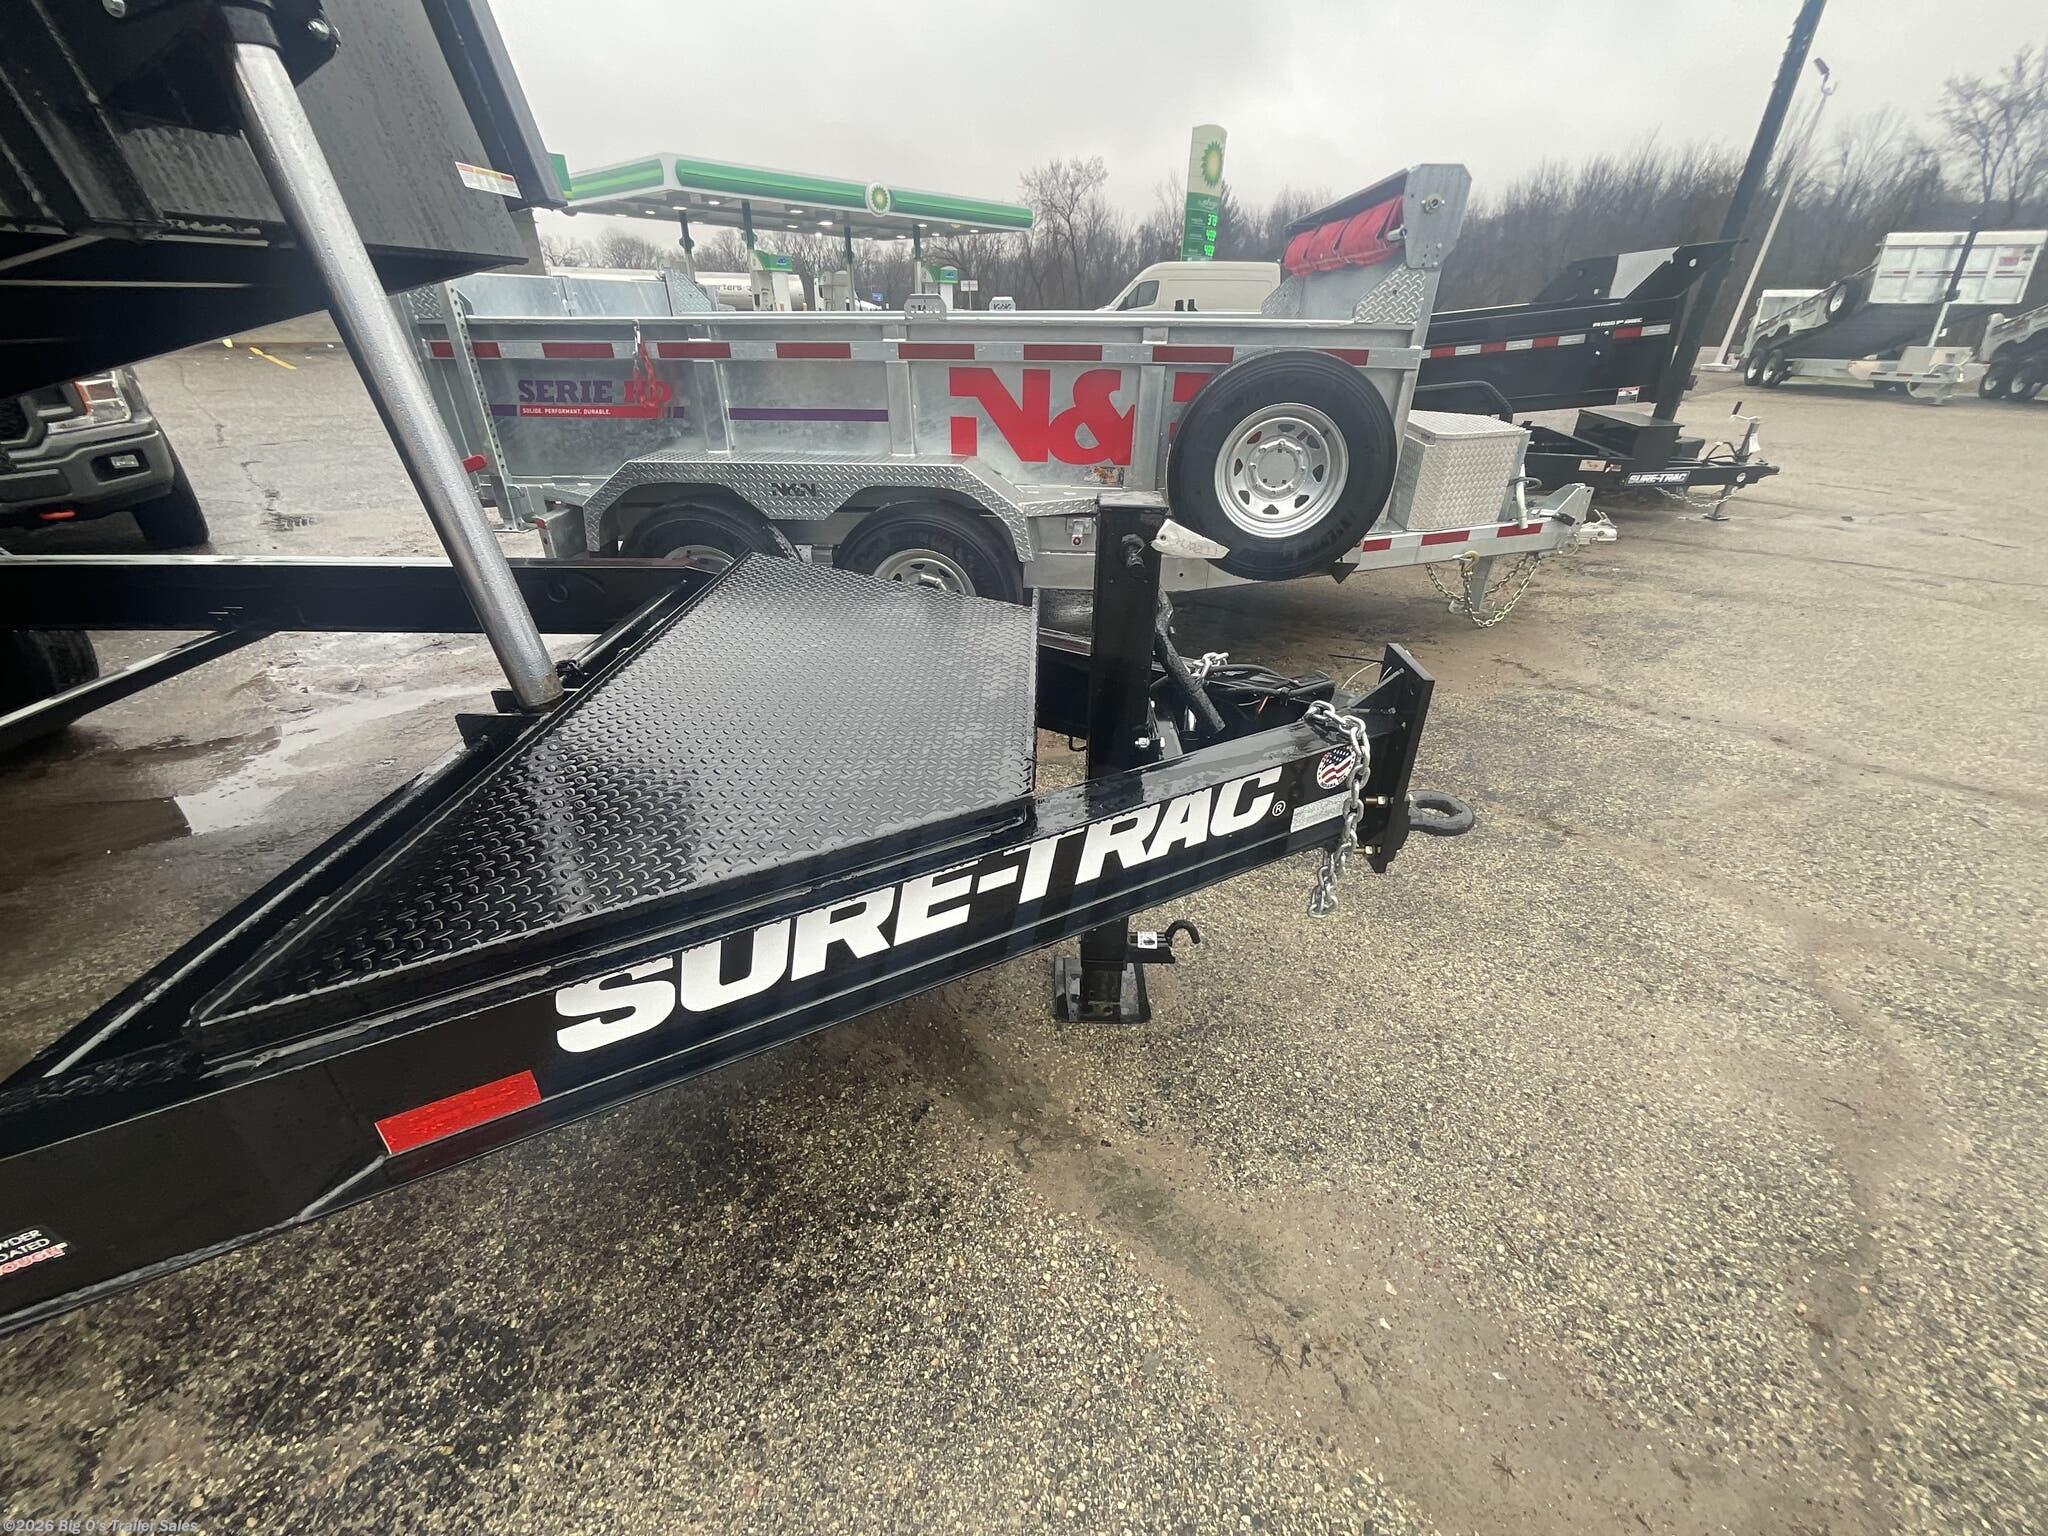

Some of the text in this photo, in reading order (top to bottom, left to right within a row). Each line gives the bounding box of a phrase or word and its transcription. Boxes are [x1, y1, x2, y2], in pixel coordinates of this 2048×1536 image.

[518, 380, 613, 403] SERIE
[583, 408, 611, 416] DURABLE.
[1627, 472, 1688, 484] SURE-TRAC
